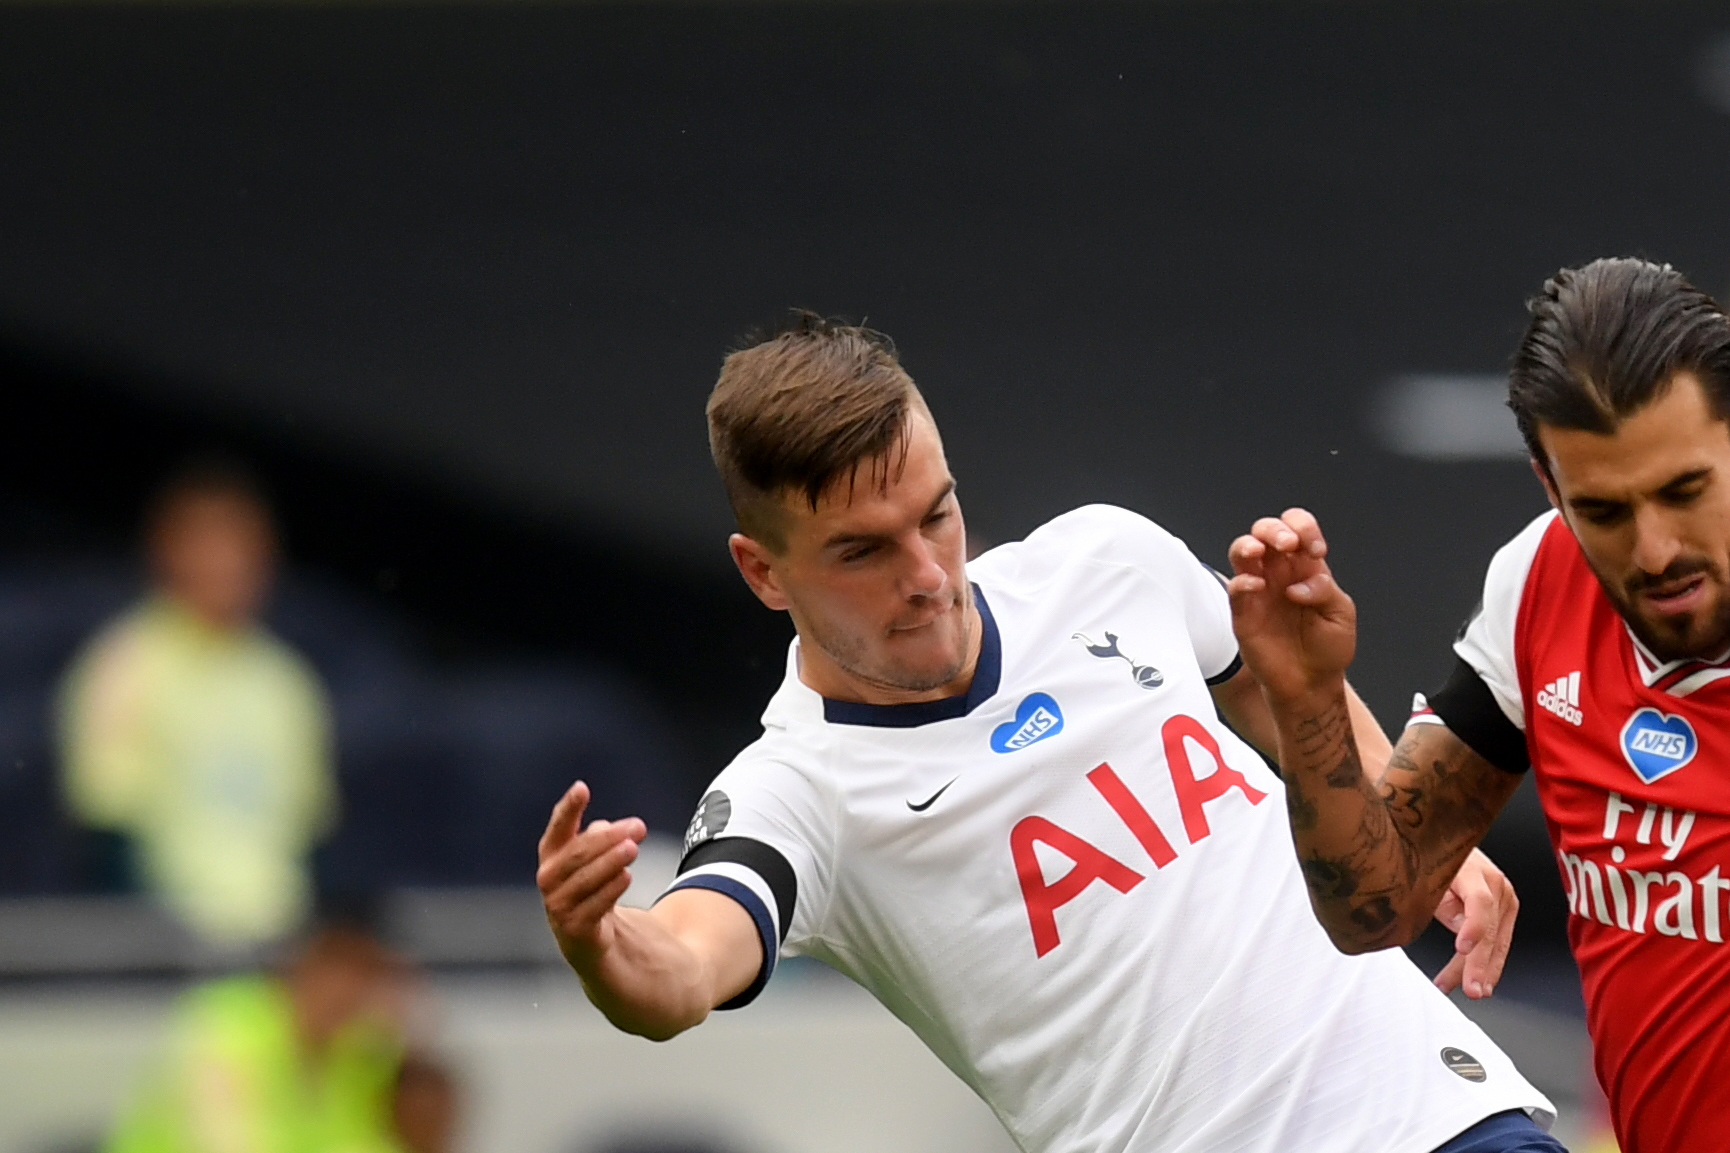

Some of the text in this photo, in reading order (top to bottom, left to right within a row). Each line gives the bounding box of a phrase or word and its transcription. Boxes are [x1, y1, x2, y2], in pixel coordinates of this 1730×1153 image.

[1537, 689, 1583, 727] adidas
[1010, 710, 1052, 747] NHS
[1635, 731, 1685, 756] NHS
[1009, 713, 1269, 959] AIA
[1603, 791, 1697, 862] Fly
